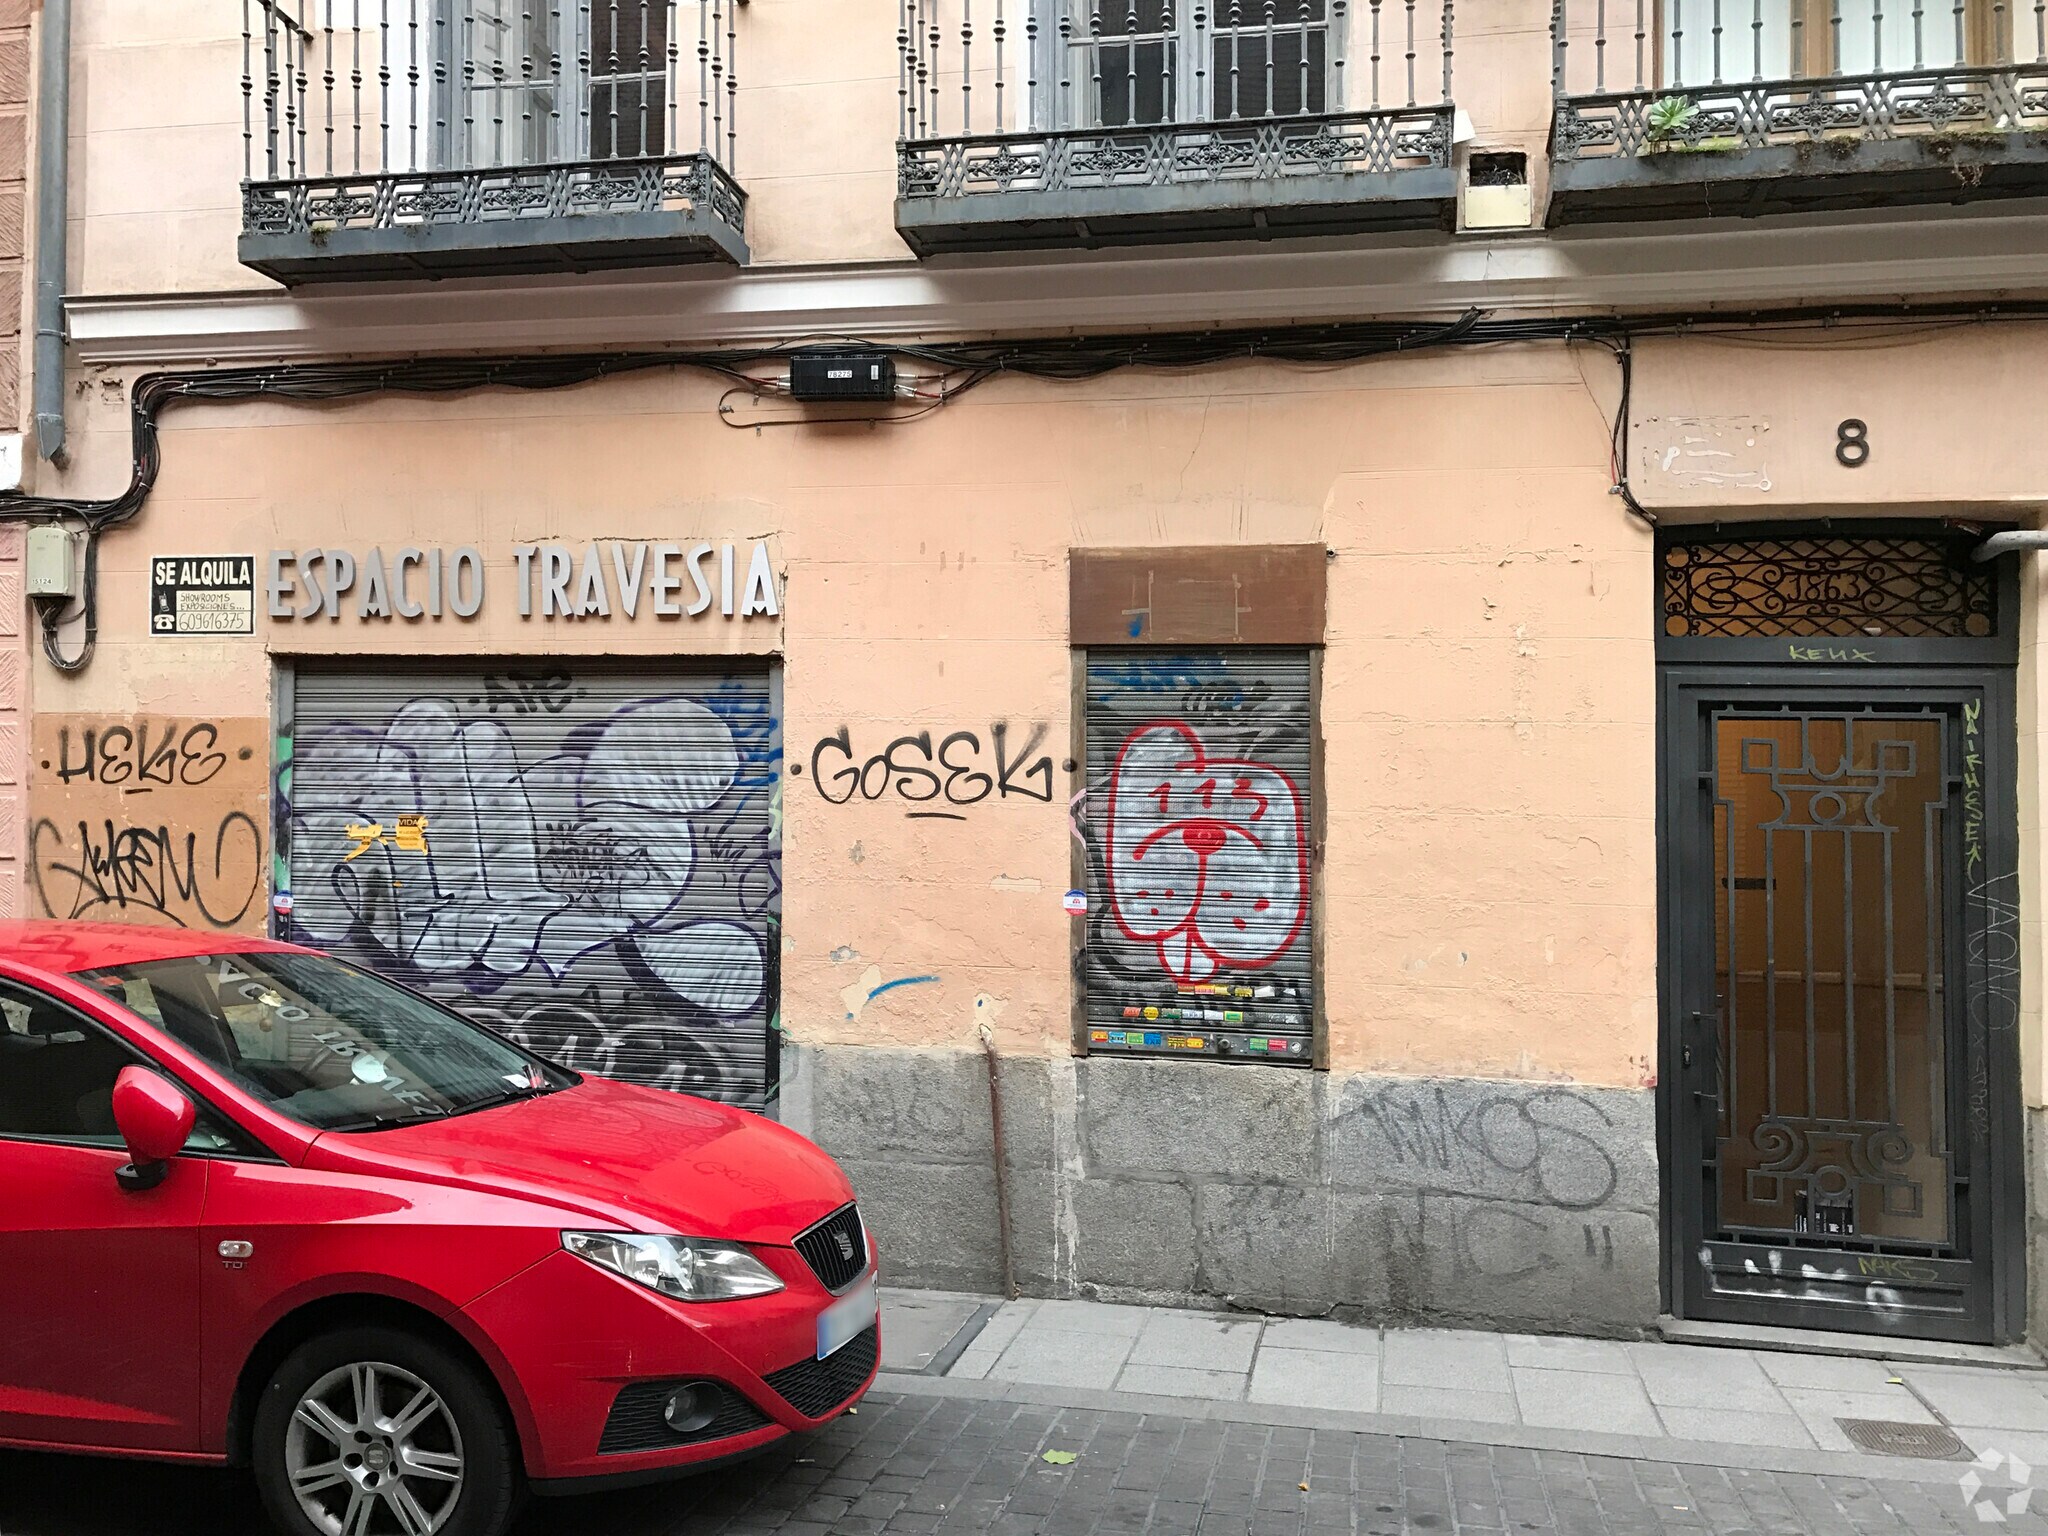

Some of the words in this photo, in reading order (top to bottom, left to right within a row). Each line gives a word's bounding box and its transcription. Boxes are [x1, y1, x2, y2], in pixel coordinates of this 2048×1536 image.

[1836, 418, 1870, 467] 8
[155, 561, 176, 585] SE
[180, 560, 251, 587] ALQUILA
[266, 545, 485, 619] ESPACIO
[513, 541, 780, 619] TRAVESIA
[1786, 573, 1861, 600] 1863
[180, 593, 230, 602] SHOWROOMS
[179, 612, 244, 631] 609616375
